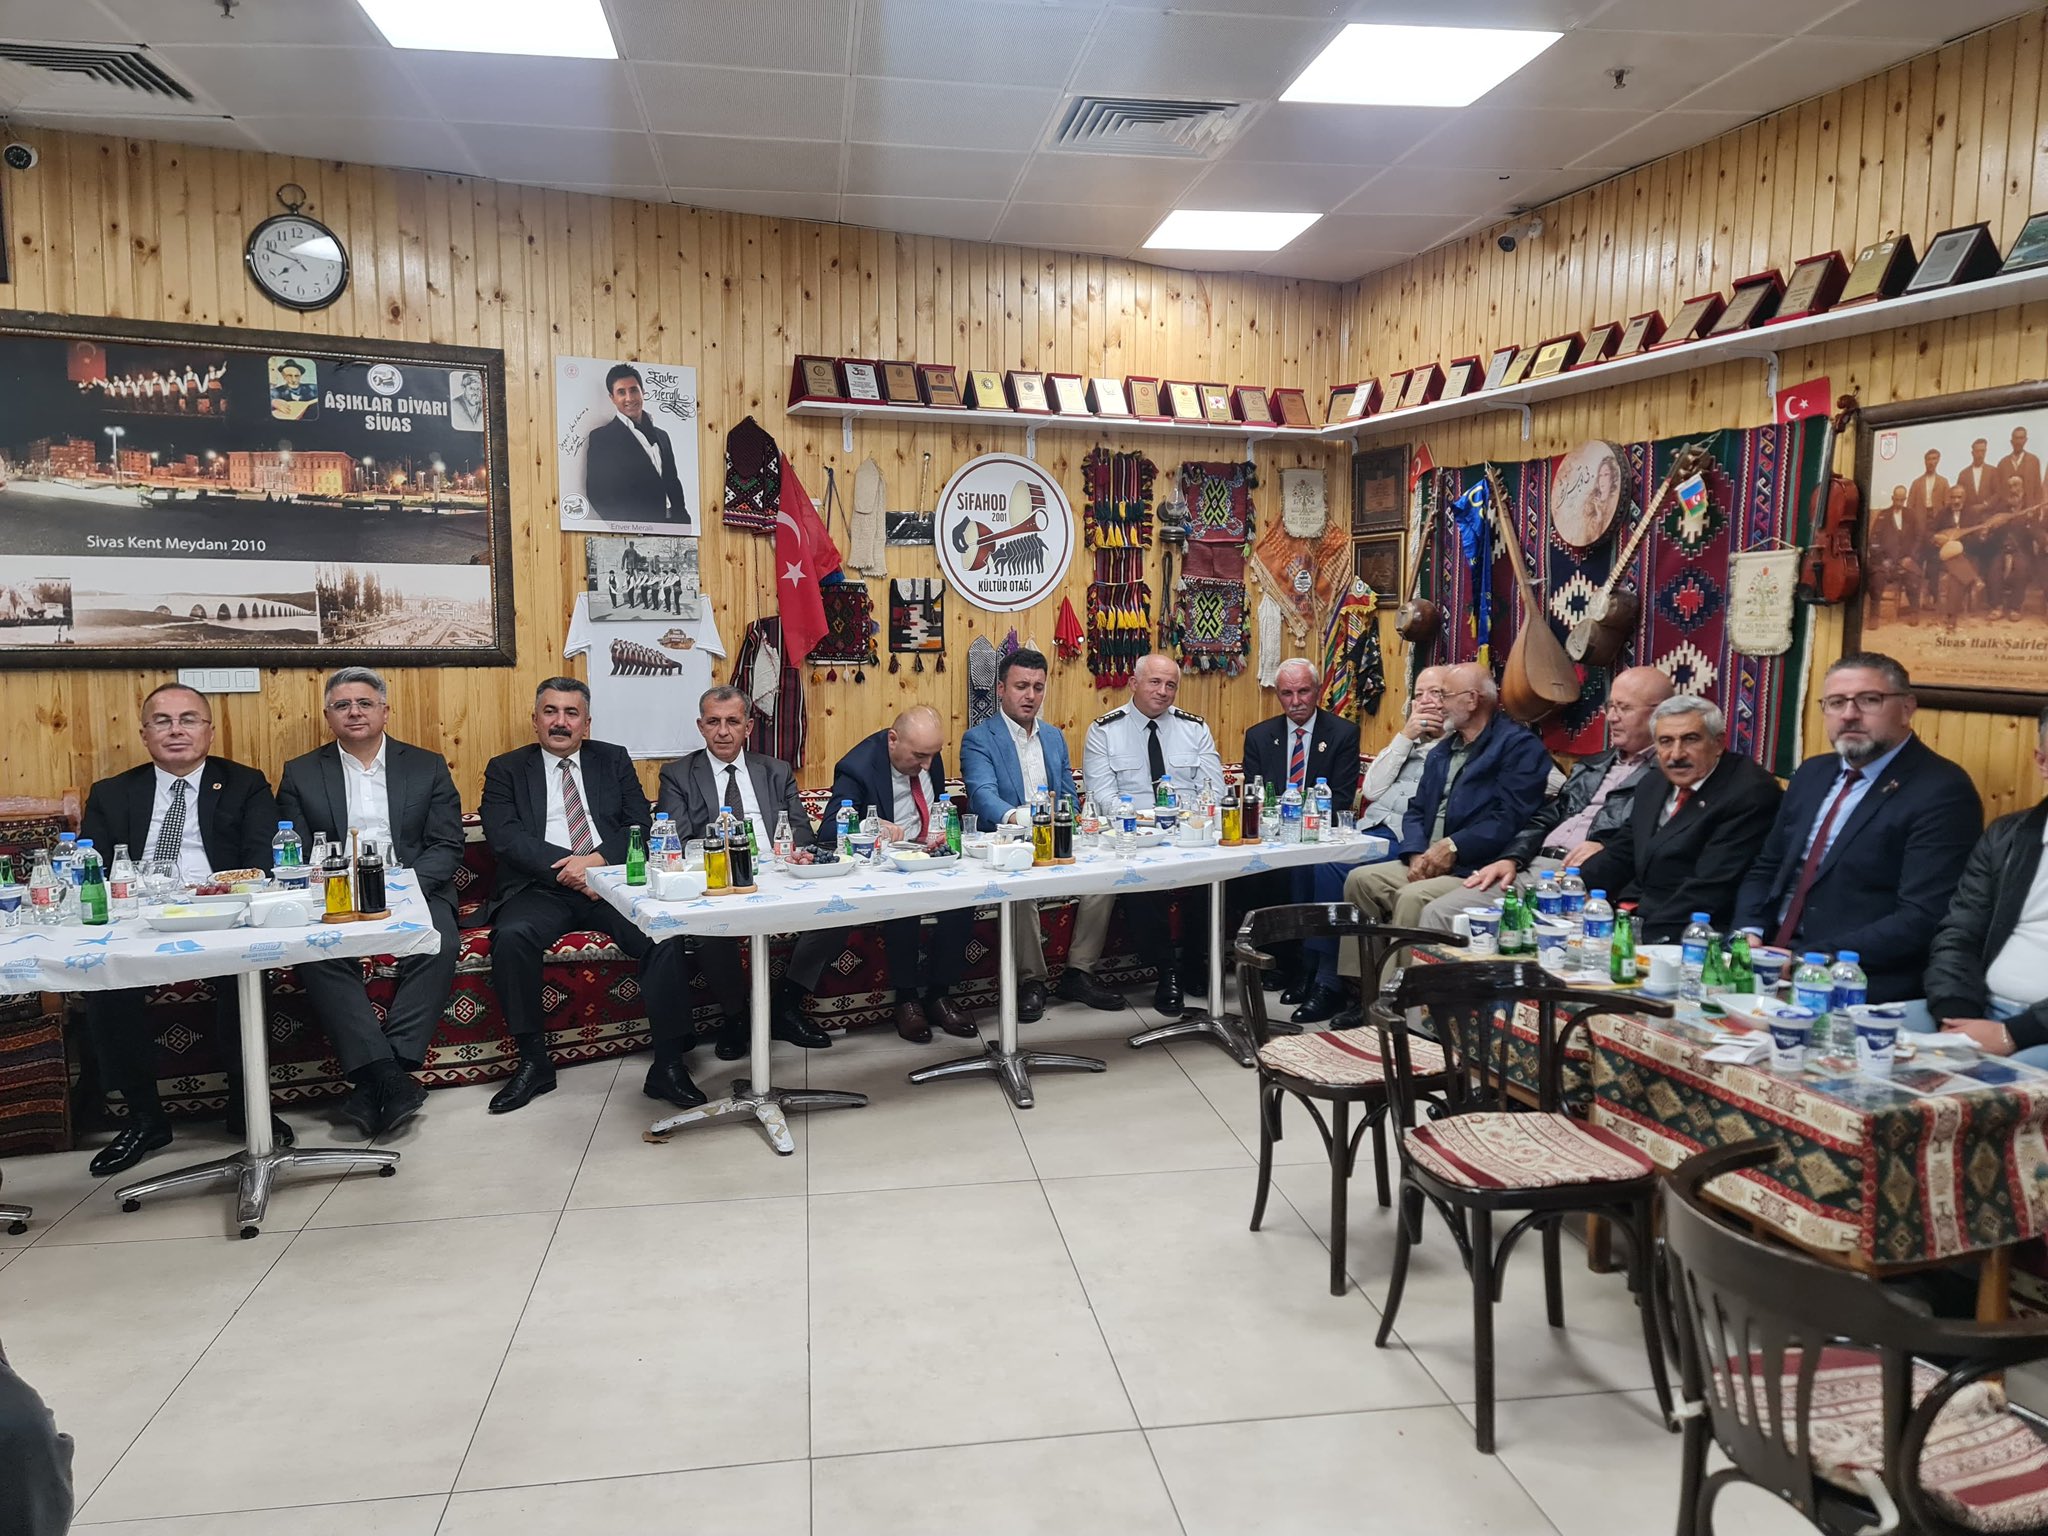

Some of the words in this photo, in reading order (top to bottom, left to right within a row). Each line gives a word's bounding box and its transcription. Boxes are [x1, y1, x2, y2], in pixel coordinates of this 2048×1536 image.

[277, 230, 287, 242] 11
[291, 227, 303, 239] 12
[265, 240, 277, 251] 10
[262, 253, 270, 263] 9
[283, 280, 289, 292] 7
[297, 285, 305, 296] 6
[314, 282, 321, 294] 5
[324, 390, 393, 413] ÂŞIKLAR
[398, 397, 448, 416] DİYARI
[365, 413, 412, 432] SİVAS
[991, 512, 1007, 522] 2001
[87, 535, 124, 549] Sivas
[127, 536, 161, 550] Kent
[165, 537, 228, 553] Meydanı
[231, 539, 267, 552] 2010
[978, 579, 1008, 592] KÜLTÜR
[1010, 578, 1032, 592] OTAĞI
[1935, 637, 1966, 648] Sivas
[1970, 638, 1999, 649] Halk
